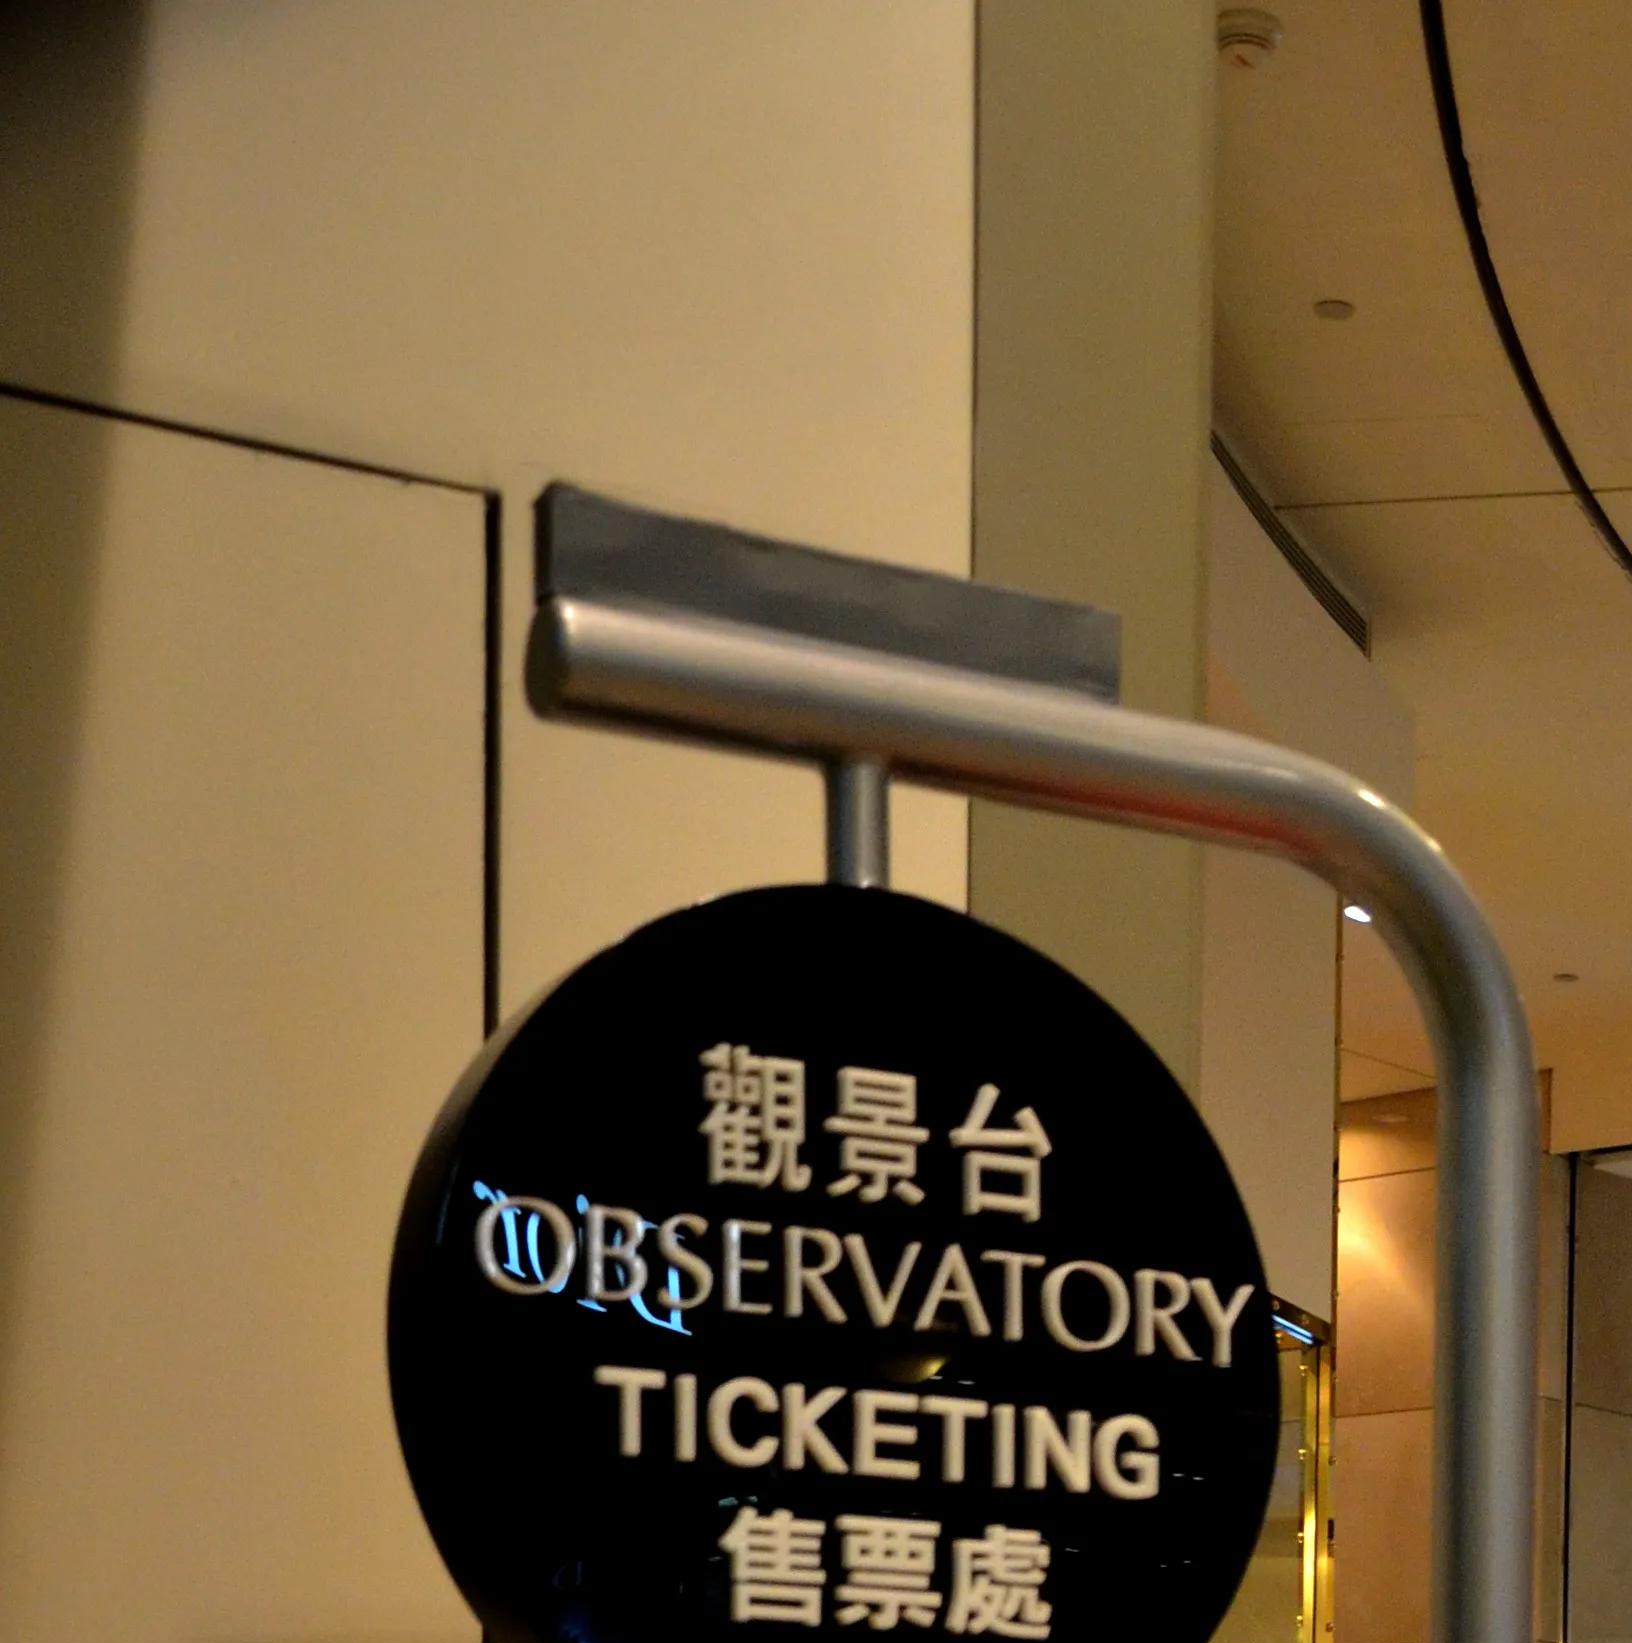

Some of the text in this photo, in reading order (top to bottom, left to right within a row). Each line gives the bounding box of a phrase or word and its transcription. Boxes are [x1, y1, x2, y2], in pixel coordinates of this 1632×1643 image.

[698, 1042, 1053, 1222] 觀景台
[475, 1194, 1256, 1368] OBSERVATORY
[594, 1364, 1161, 1500] TICKETING
[718, 1506, 1054, 1641] 售票處
